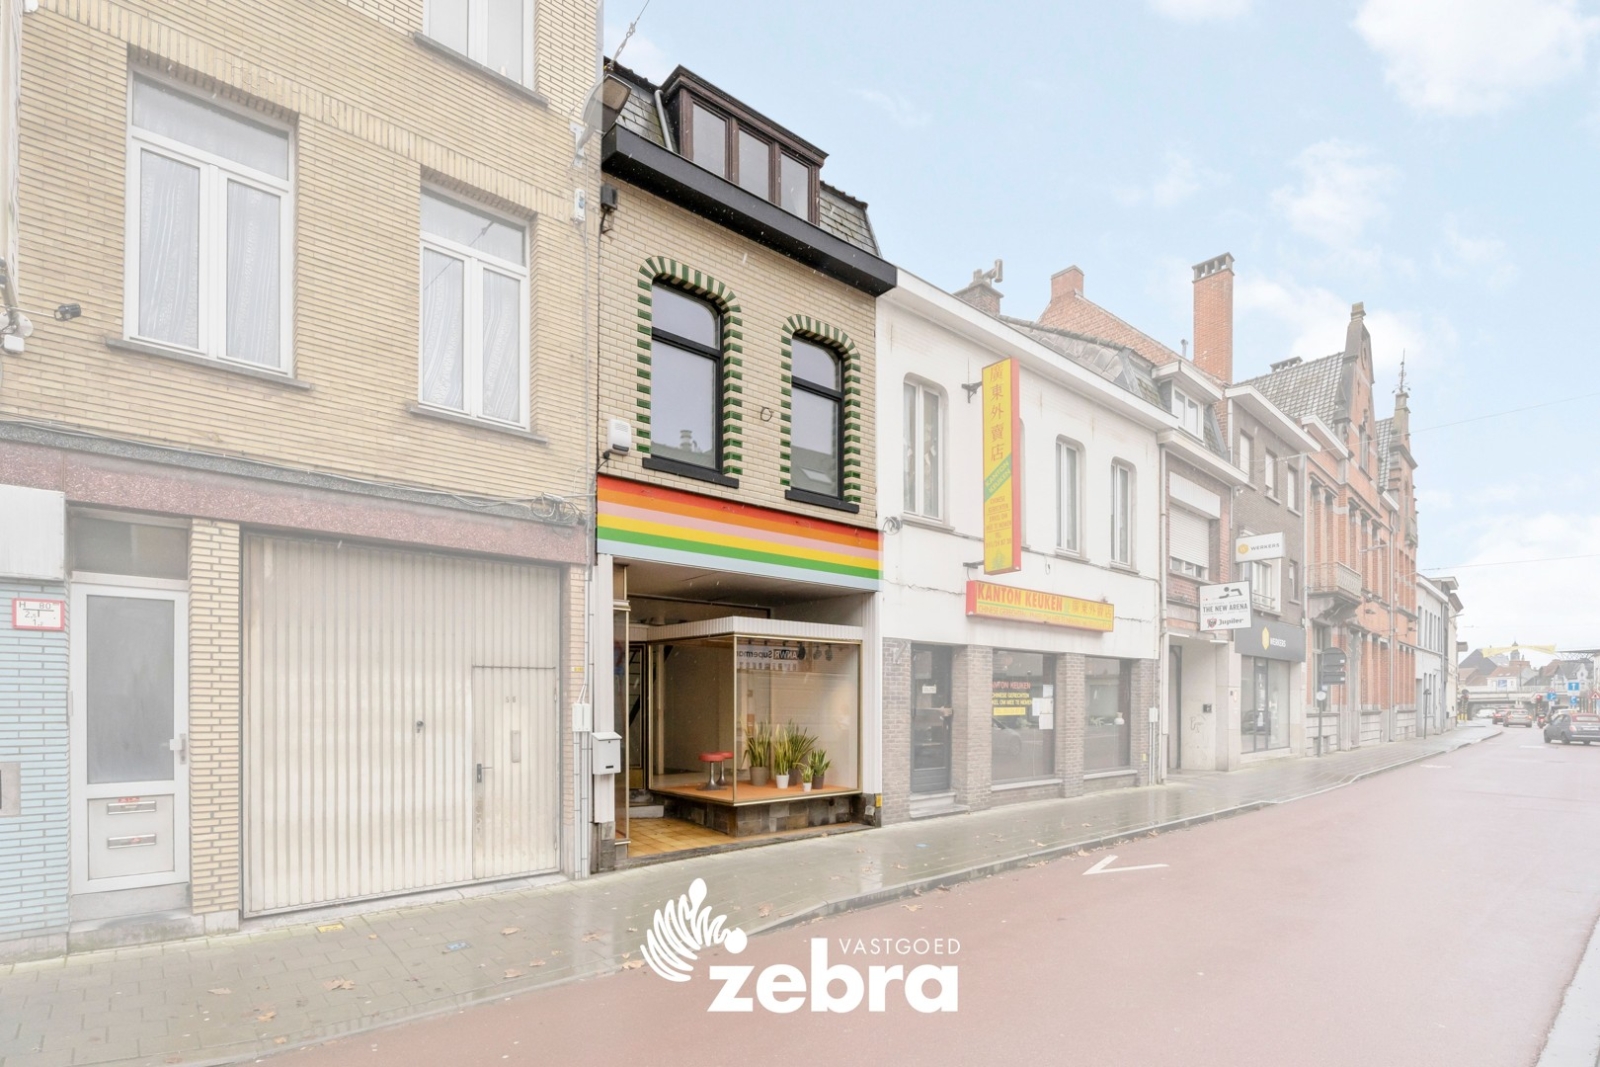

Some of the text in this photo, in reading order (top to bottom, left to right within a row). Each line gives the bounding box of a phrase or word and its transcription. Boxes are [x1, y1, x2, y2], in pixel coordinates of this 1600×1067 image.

[1250, 543, 1280, 551] WERKERS
[978, 583, 1063, 612] KANTON KEUKEN
[1203, 605, 1213, 613] THE
[1215, 604, 1228, 612] NEW
[1229, 602, 1248, 611] ARENA
[1218, 617, 1244, 626] Jupiler
[992, 681, 1031, 690] ANTON KEUKEN
